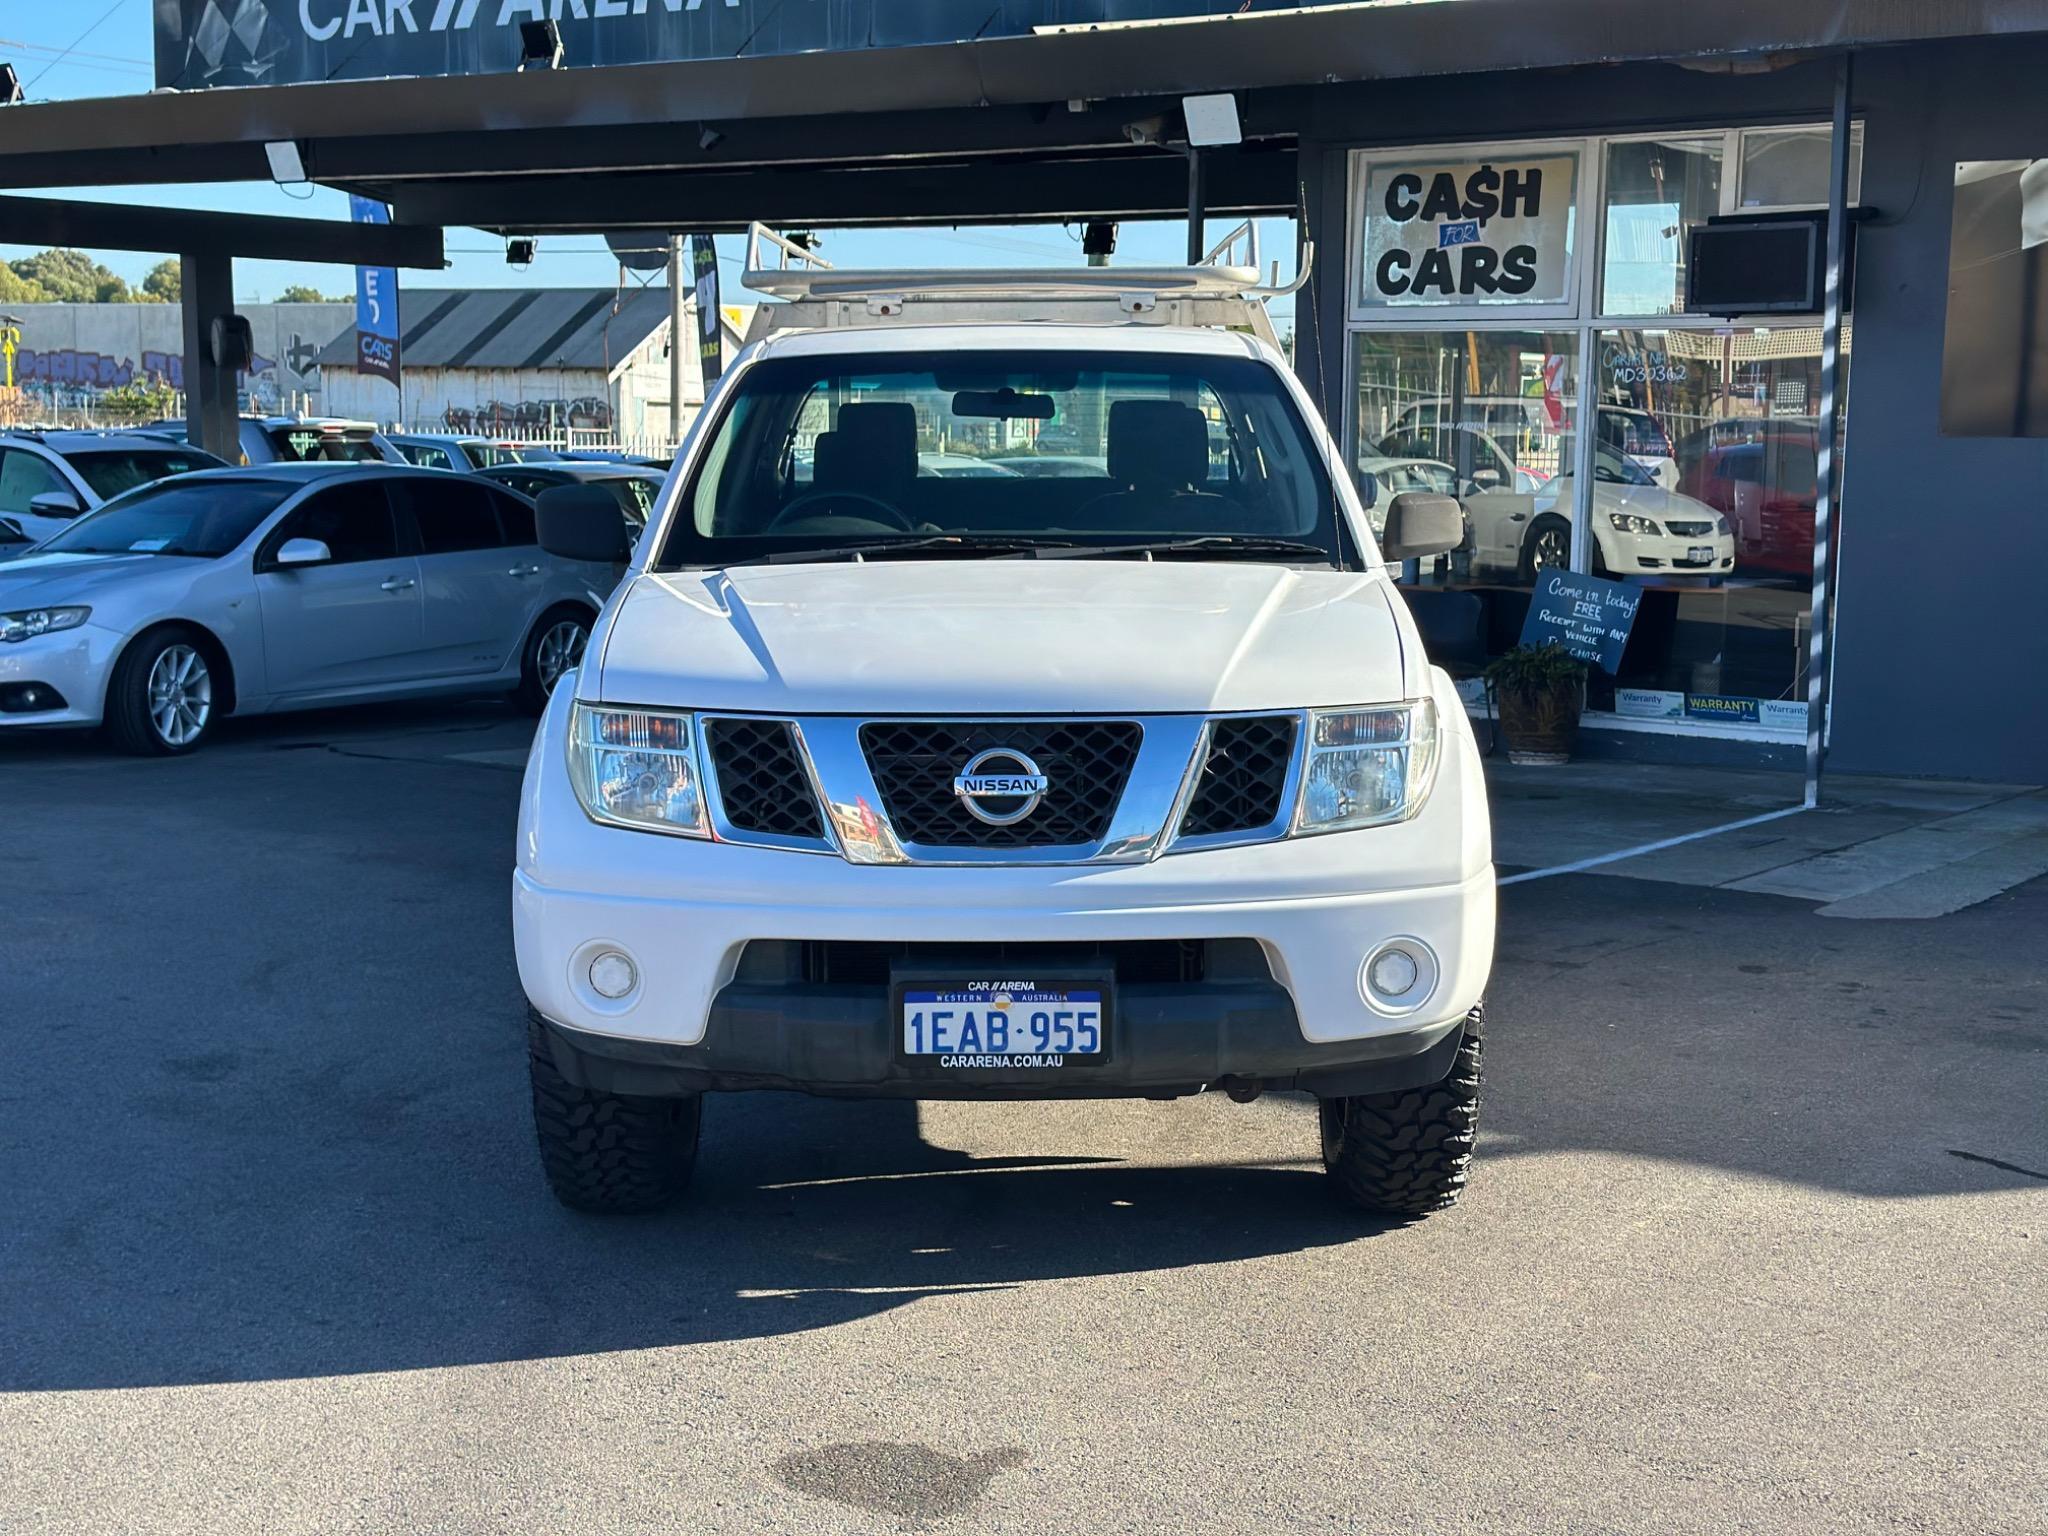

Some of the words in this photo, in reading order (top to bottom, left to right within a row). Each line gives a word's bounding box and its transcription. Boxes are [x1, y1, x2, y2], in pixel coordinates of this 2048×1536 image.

[1384, 165, 1542, 228] CA$H
[1443, 225, 1474, 246] FOR
[1376, 244, 1537, 296] CARS
[1548, 577, 1583, 599] Come
[1585, 591, 1599, 602] in
[1605, 588, 1640, 618] today!
[1573, 601, 1602, 619] FREE
[1609, 628, 1628, 644] ANY
[1623, 692, 1663, 705] Warranty
[1690, 698, 1755, 711] WARRANTY
[964, 779, 1038, 791] NISSAN
[968, 981, 990, 991] CAR
[1021, 994, 1068, 1002] AUSTRALIA
[940, 1055, 1063, 1068] CARARENA.COM.AU
